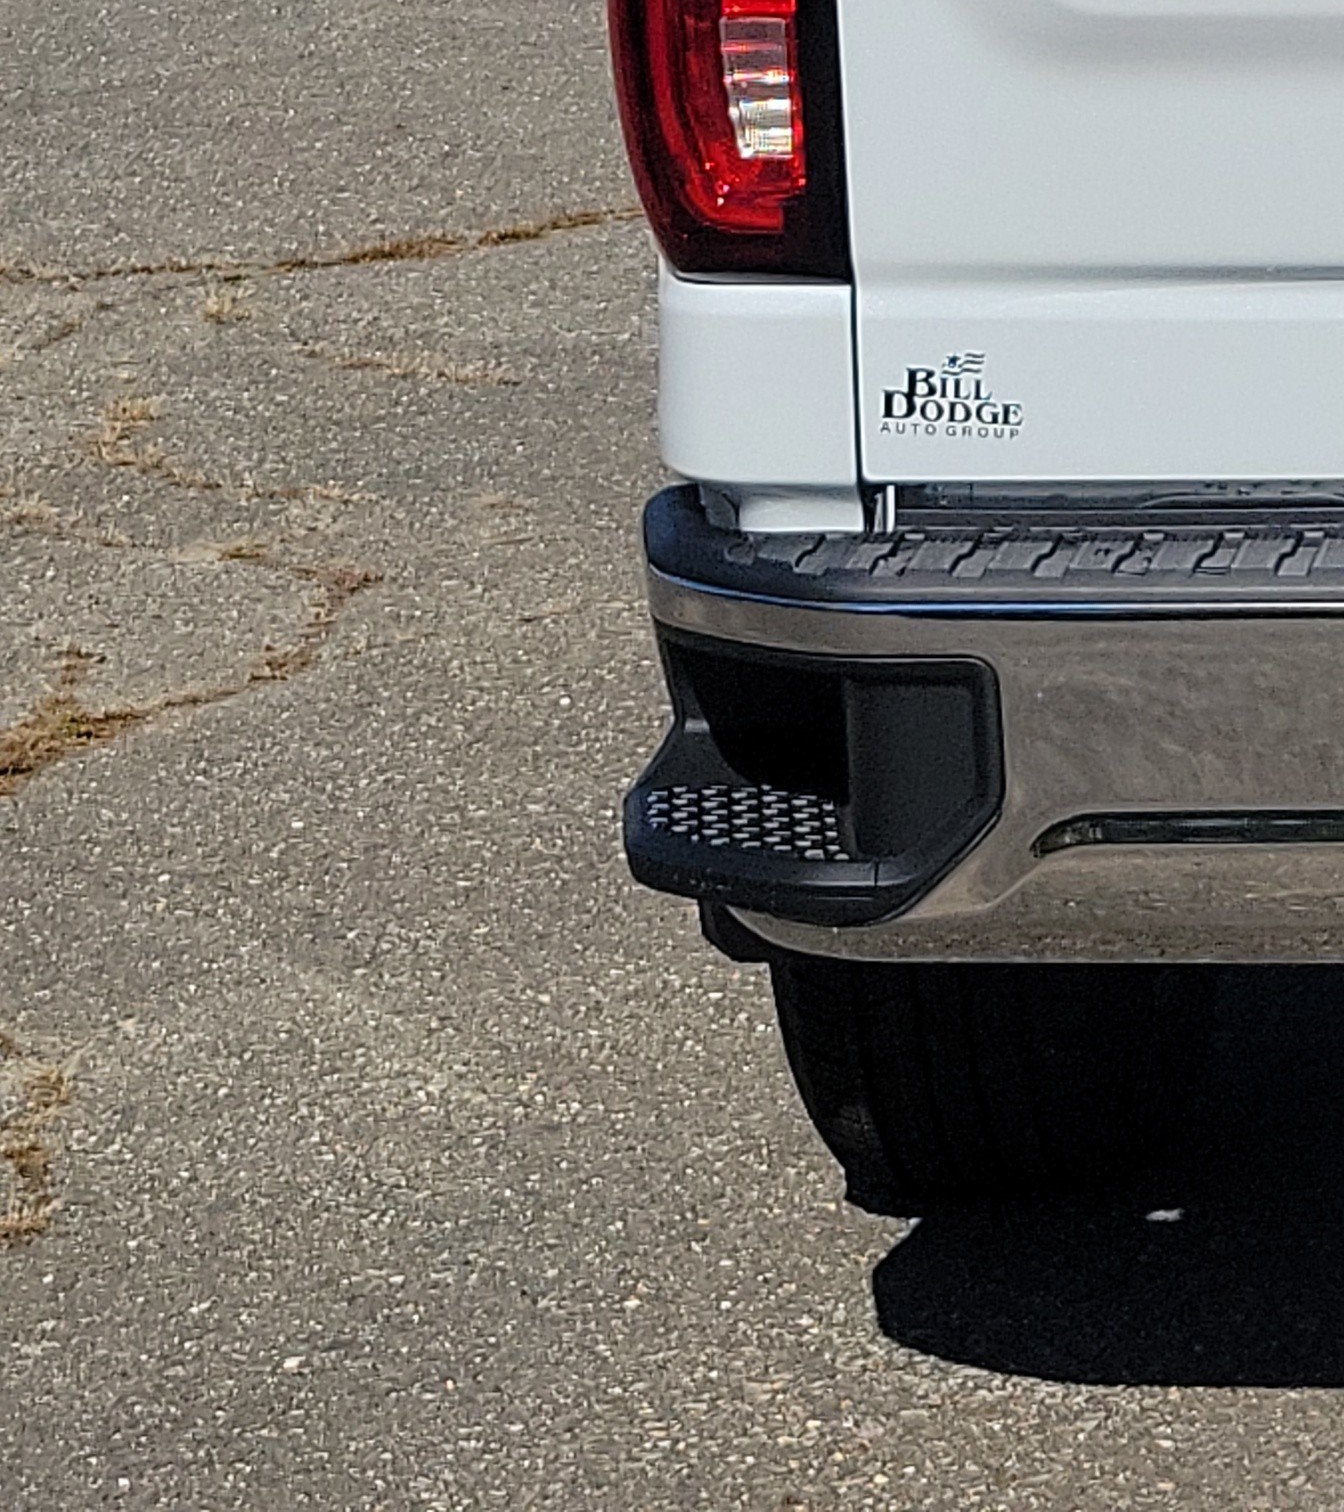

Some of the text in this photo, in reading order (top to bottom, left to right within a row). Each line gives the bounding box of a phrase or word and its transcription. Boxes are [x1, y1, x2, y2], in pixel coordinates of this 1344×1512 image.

[906, 368, 992, 400] BILL
[882, 390, 1023, 426] DODGE
[881, 422, 1019, 439] AUTO GROUP
